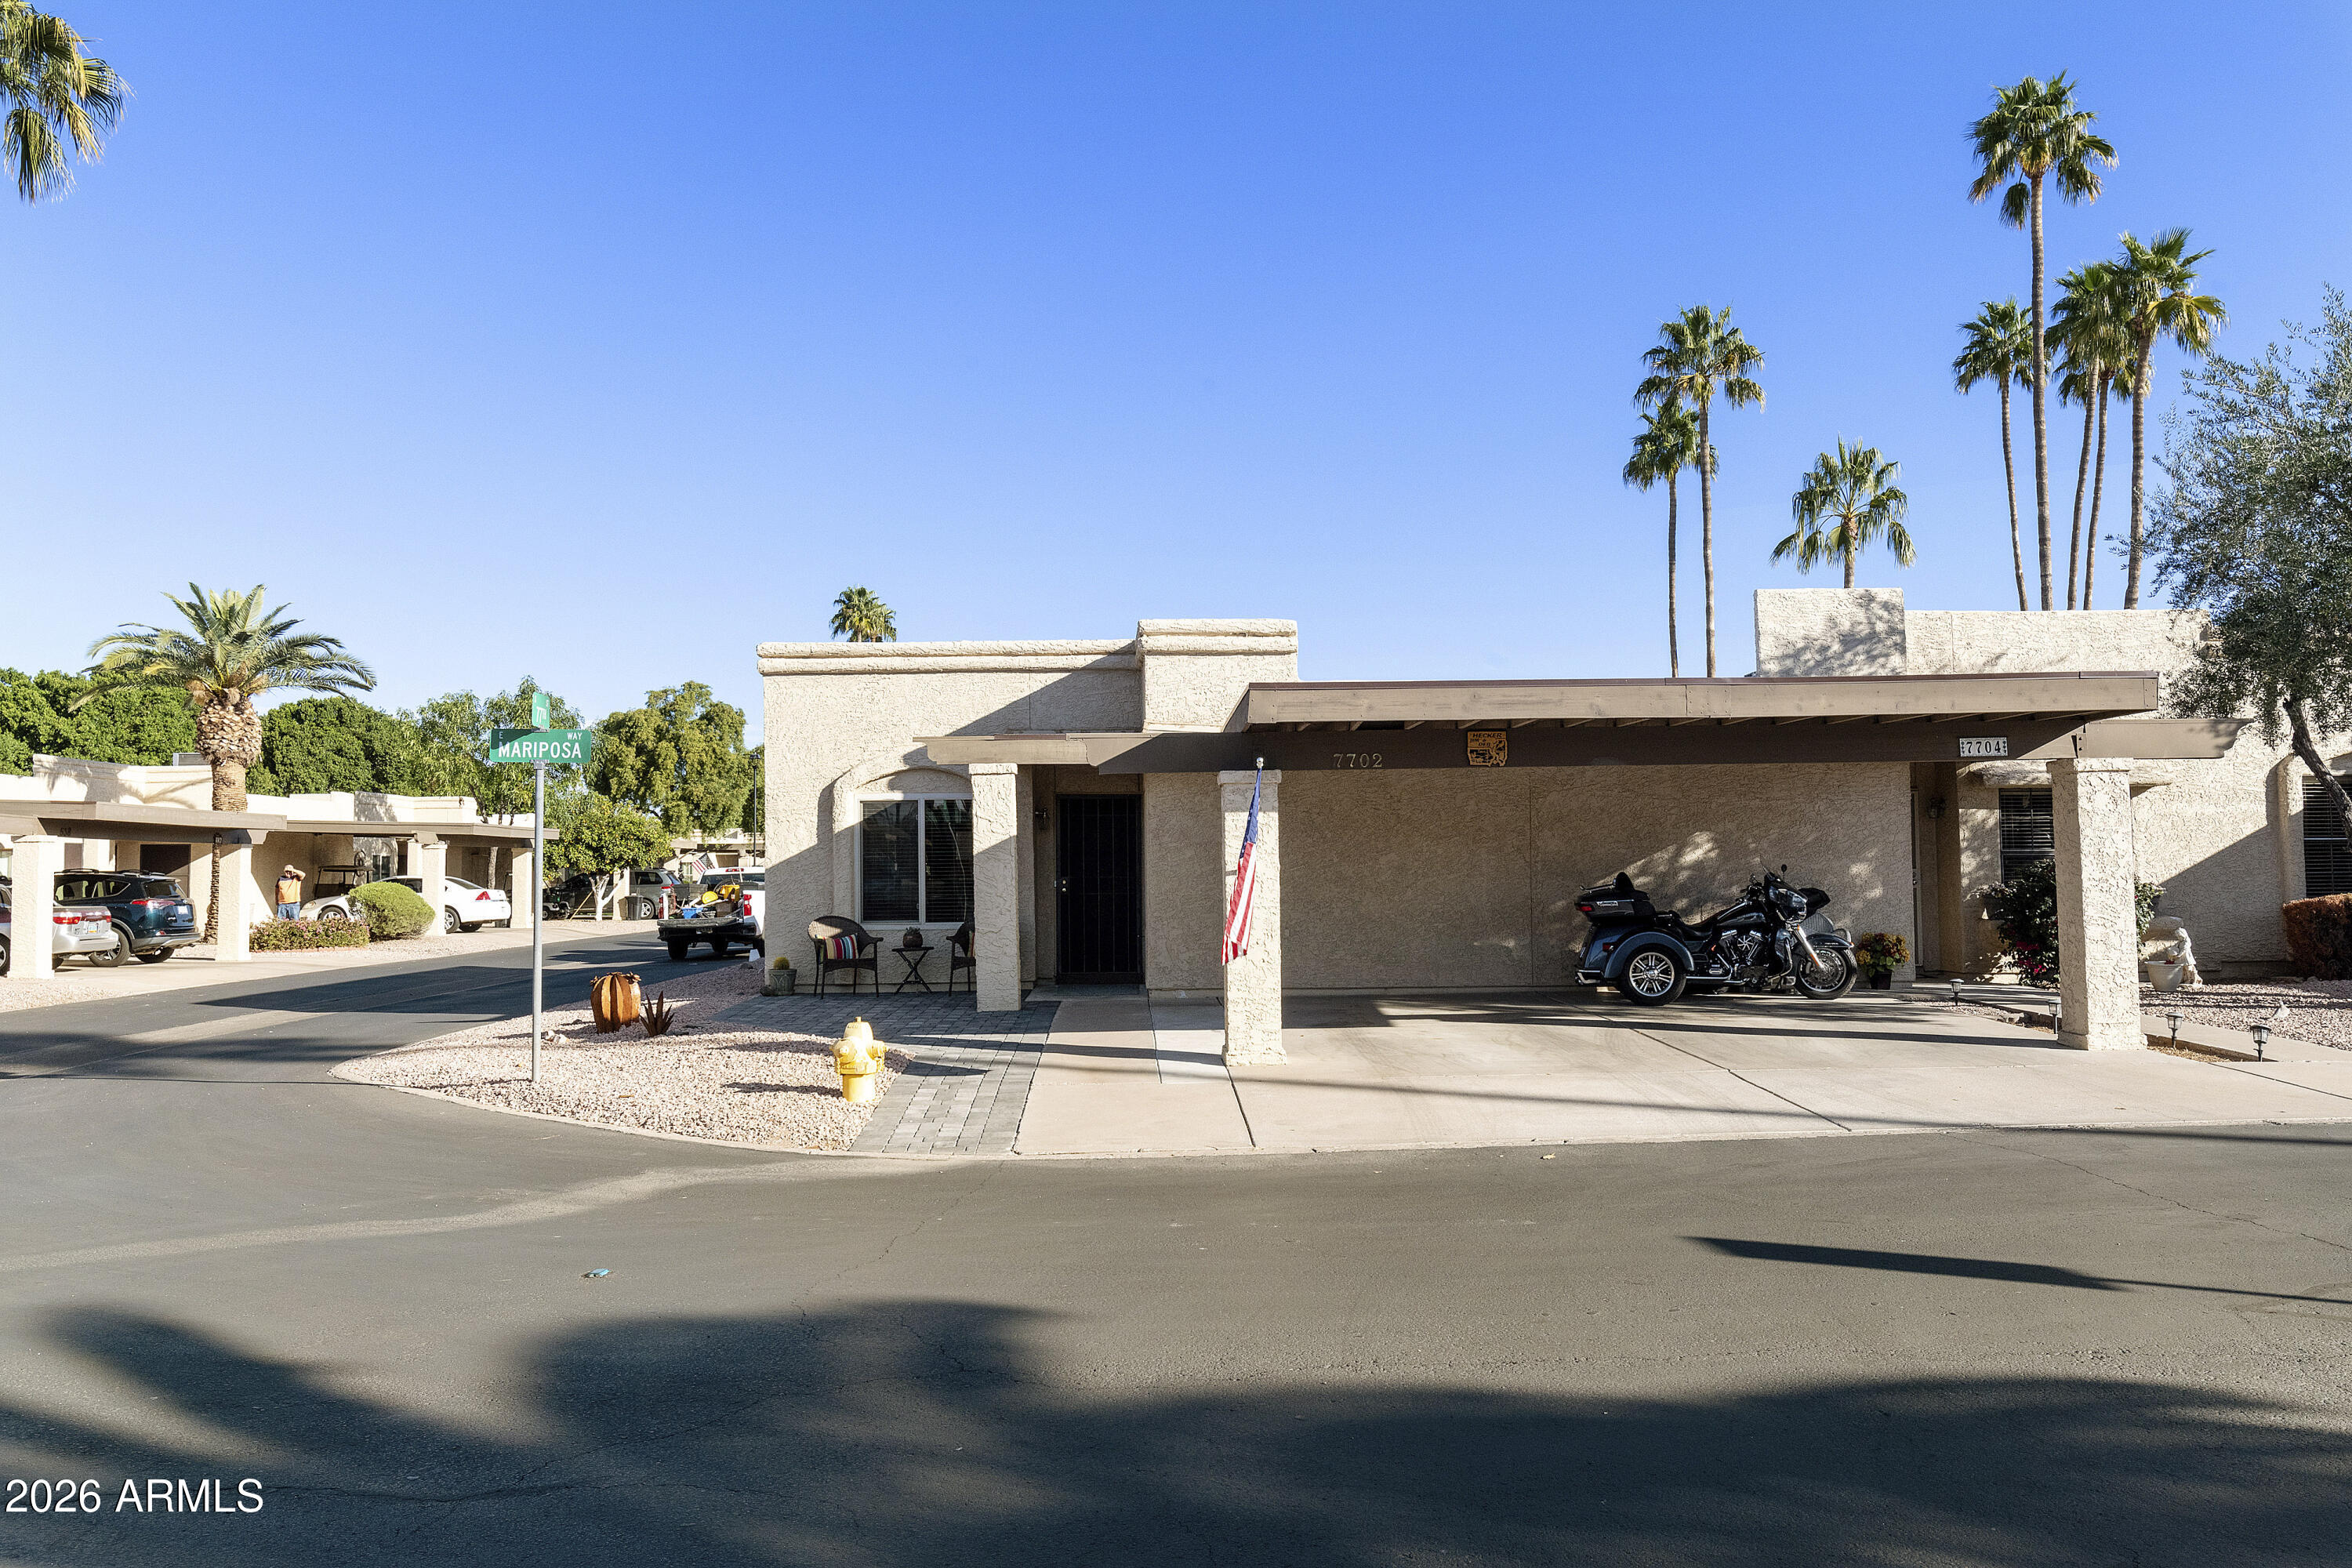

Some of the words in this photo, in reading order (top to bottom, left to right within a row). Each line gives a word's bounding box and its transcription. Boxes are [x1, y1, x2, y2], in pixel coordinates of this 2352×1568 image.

[499, 742, 582, 758] MARIPOSA
[1965, 741, 2001, 753] 7704
[1333, 753, 1382, 768] 7702
